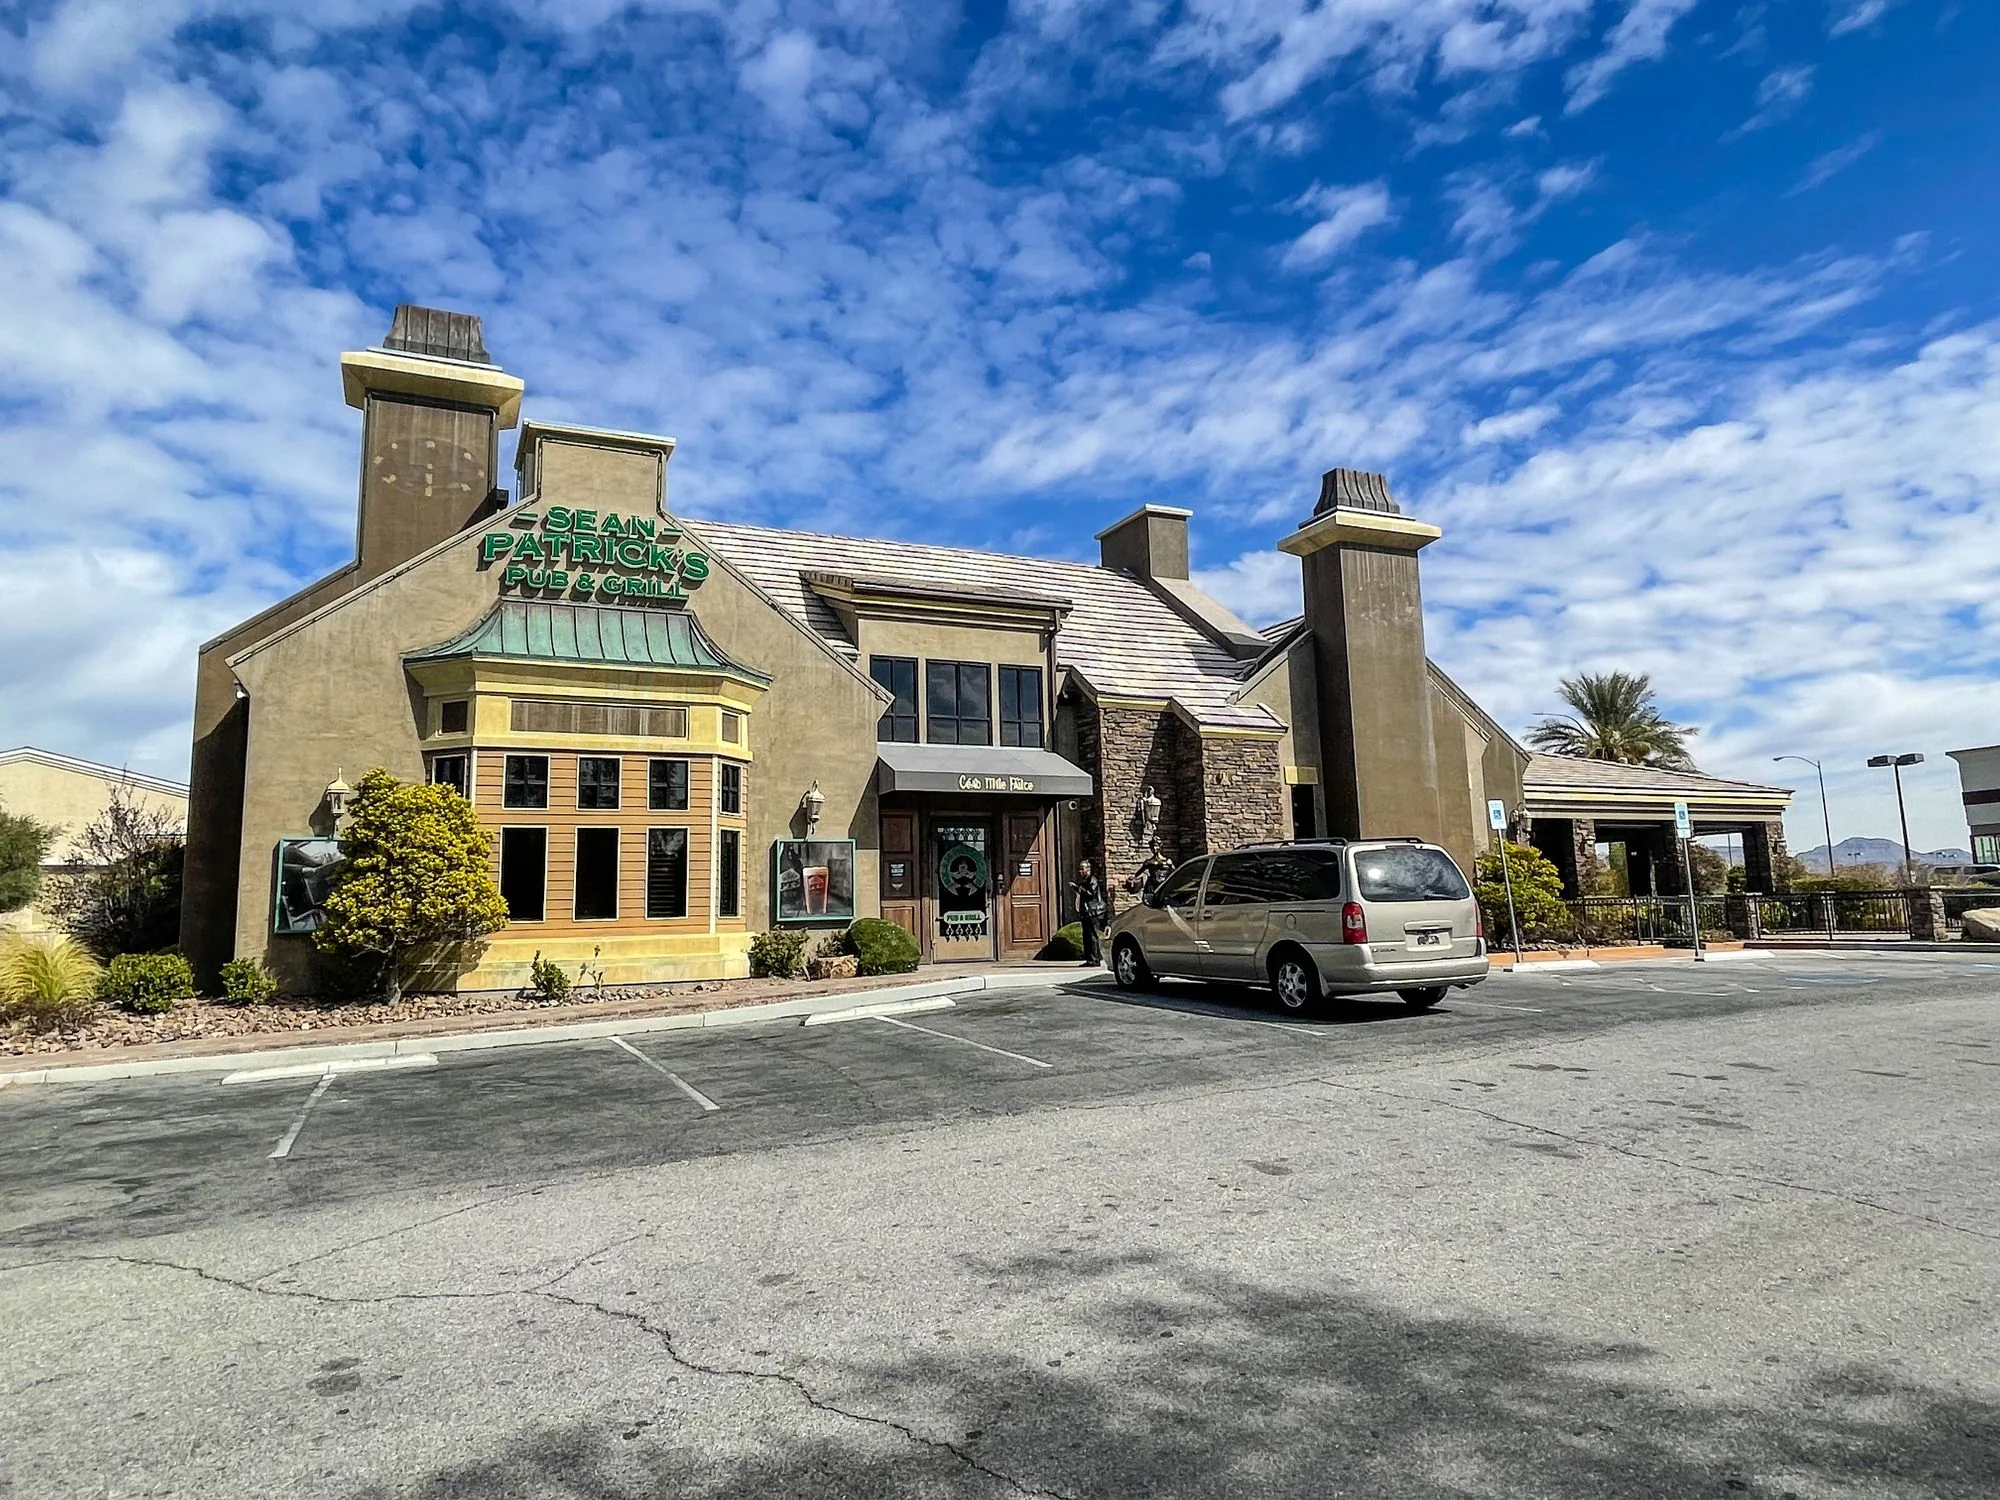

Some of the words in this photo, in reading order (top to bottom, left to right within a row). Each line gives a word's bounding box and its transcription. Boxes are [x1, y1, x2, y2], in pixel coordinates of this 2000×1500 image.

[546, 506, 656, 539] SEAN
[484, 532, 711, 581] PATRICK'S
[504, 565, 570, 589] PUB
[576, 572, 596, 593] &
[603, 575, 690, 600] GRILL
